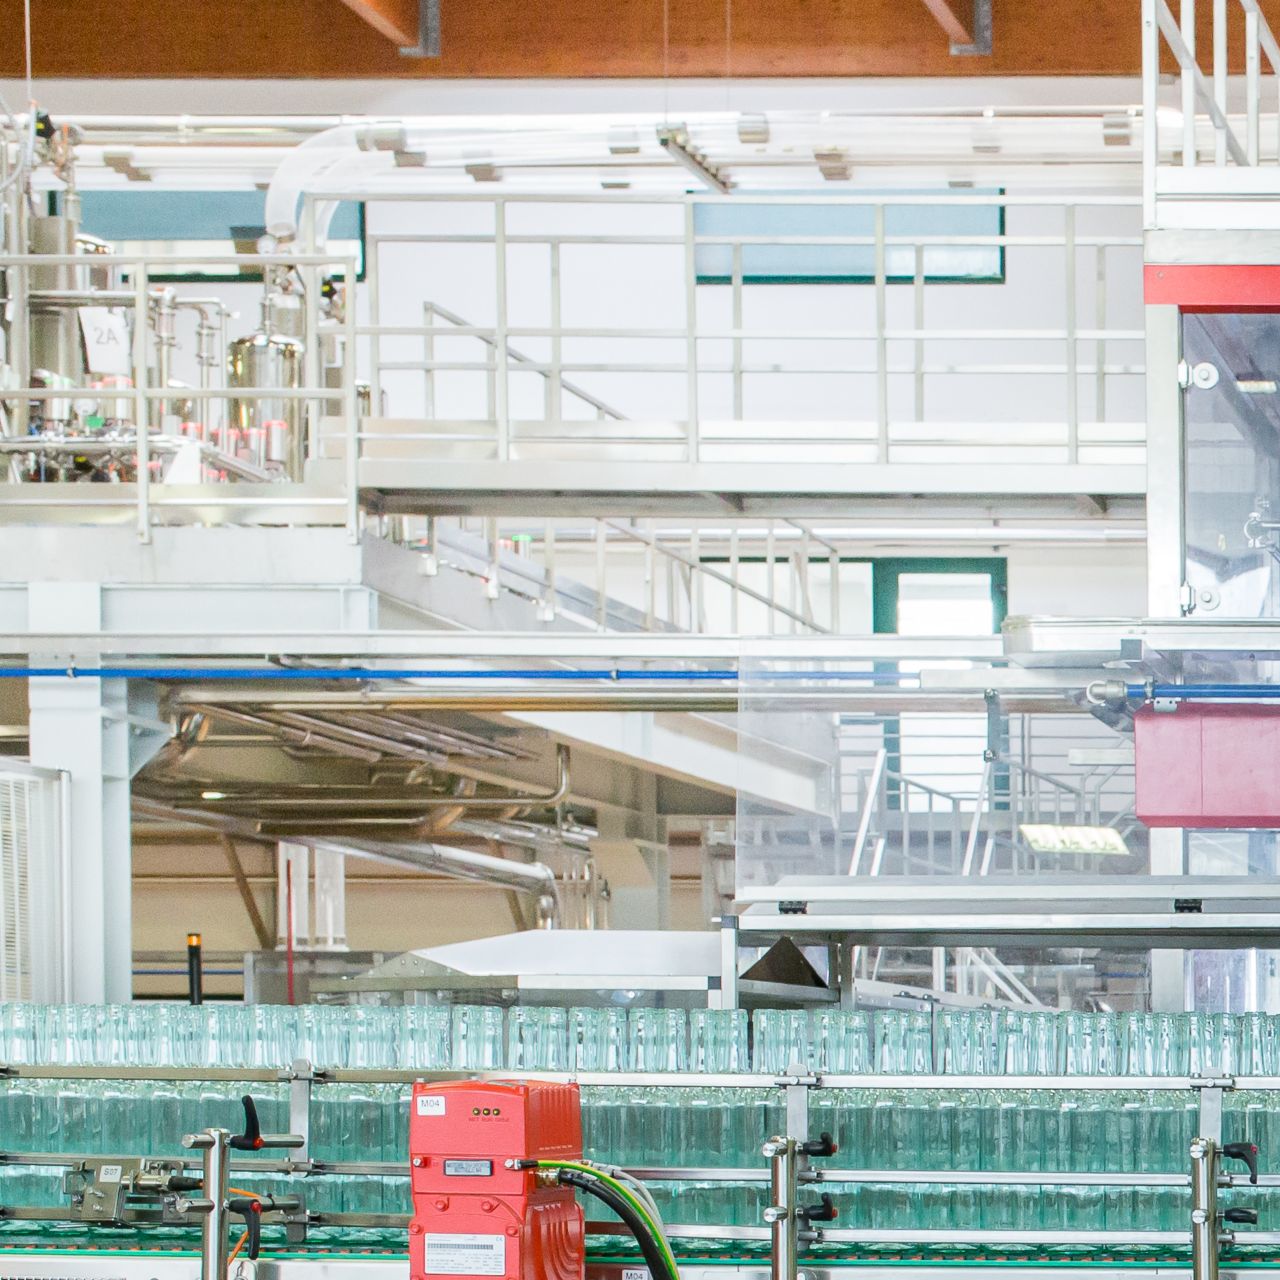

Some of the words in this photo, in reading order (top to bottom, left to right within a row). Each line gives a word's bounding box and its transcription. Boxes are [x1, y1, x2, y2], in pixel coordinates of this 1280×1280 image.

[94, 327, 119, 344] 2A
[420, 1100, 440, 1108] M04
[625, 1272, 644, 1280] M04
